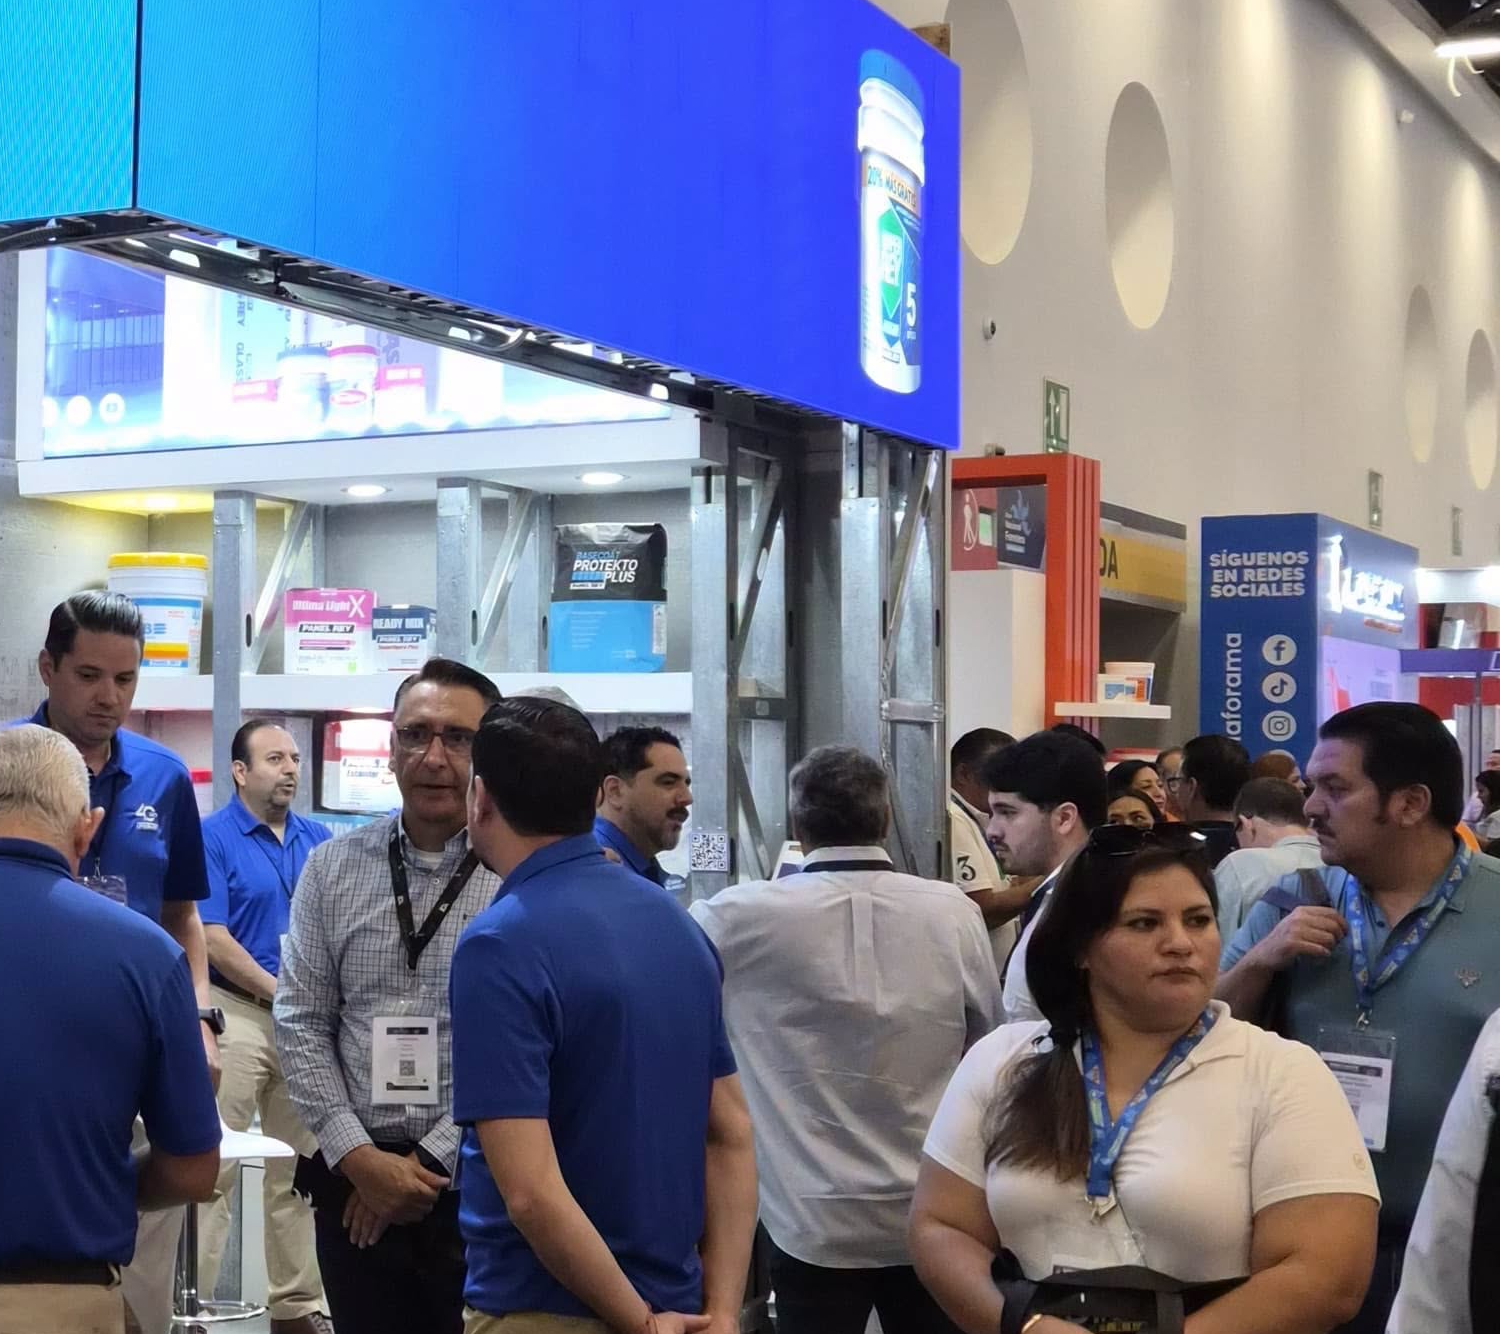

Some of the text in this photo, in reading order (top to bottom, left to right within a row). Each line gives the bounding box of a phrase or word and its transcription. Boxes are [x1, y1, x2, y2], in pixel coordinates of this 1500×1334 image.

[572, 559, 638, 572] PROTEKTO
[1209, 549, 1310, 567] SÍGUENOS
[604, 571, 636, 583] PLUS
[1212, 567, 1305, 583] EN REDES
[1209, 582, 1306, 598] SOCIALES
[1220, 632, 1243, 741] aforama
[957, 855, 977, 882] 3
